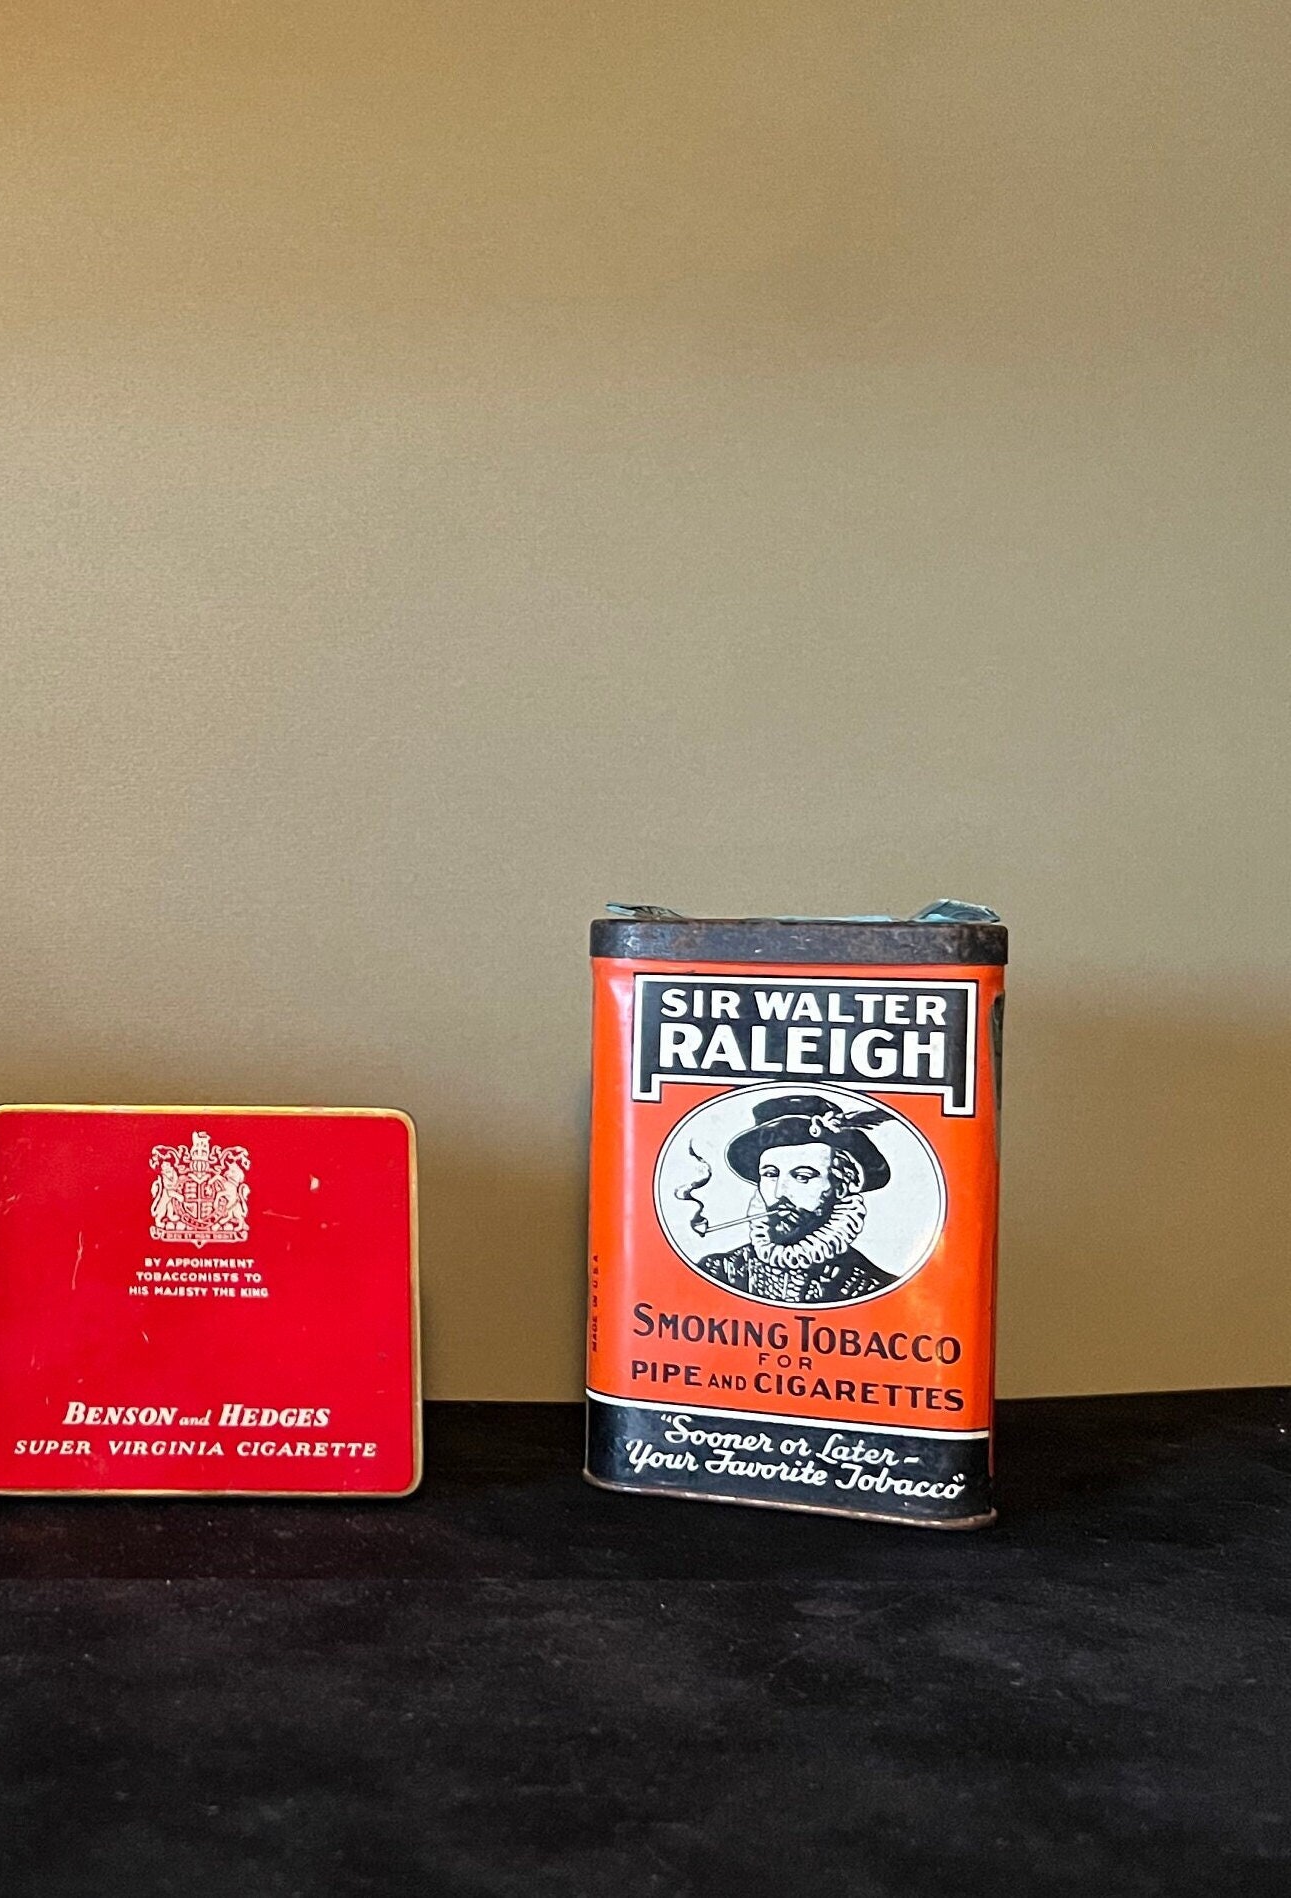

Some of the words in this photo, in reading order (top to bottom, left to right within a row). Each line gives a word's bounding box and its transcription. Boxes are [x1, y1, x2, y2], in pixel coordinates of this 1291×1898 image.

[660, 987, 744, 1020] SIR
[754, 989, 947, 1026] WALTER
[659, 1022, 946, 1079] RALEIGH
[144, 1257, 162, 1268] BY
[166, 1257, 255, 1269] APPOINTMENT
[136, 1271, 240, 1283] TOBACCONISTS
[244, 1272, 262, 1283] TO
[128, 1286, 149, 1297] HIS
[153, 1286, 208, 1298] MAJESTY
[212, 1287, 236, 1298] THE
[240, 1288, 269, 1298] KING
[632, 1302, 789, 1350] SMOKING
[795, 1315, 961, 1366] TOBACCO
[758, 1352, 813, 1371] FOR
[631, 1359, 703, 1388] PIPE
[707, 1372, 747, 1391] AND
[753, 1371, 966, 1412] CIGARETTES
[62, 1401, 177, 1427] BENSON
[179, 1408, 212, 1427] and
[218, 1403, 331, 1428] HEDGES
[14, 1439, 92, 1455] SUPER
[109, 1440, 224, 1457] VIRGINIA
[237, 1441, 377, 1458] CIGARETTE
[779, 1436, 810, 1457] or
[626, 1439, 701, 1475] Your
[704, 1444, 828, 1488] Favorite
